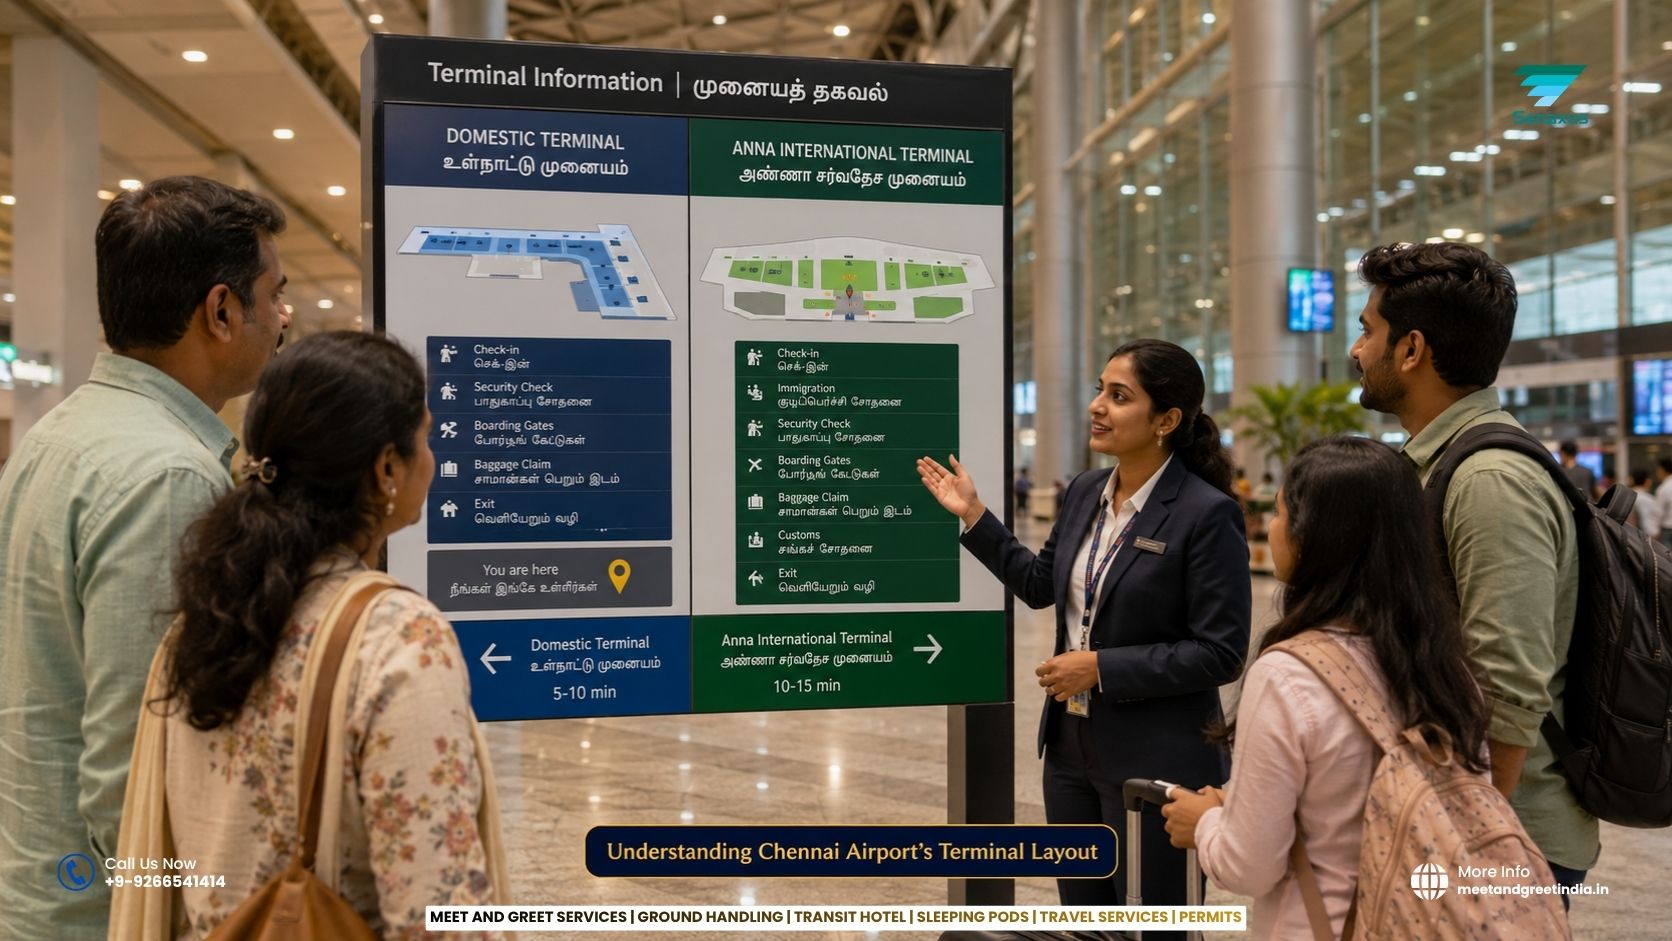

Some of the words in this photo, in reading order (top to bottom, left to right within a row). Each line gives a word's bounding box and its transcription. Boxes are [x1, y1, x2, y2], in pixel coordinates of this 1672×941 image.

[427, 61, 527, 86] Terminal
[534, 66, 663, 92] Information
[693, 77, 807, 104] முனையத்
[812, 81, 889, 105] தகவல்
[446, 127, 536, 147] DOMESTIC
[539, 131, 625, 150] TERMINAL
[732, 140, 776, 157] ANNA
[780, 142, 897, 161] INTERNATIONAL
[899, 146, 974, 164] TERMINAL
[443, 152, 536, 177] உள்நாட்டு
[540, 158, 629, 178] முனையம்
[738, 164, 812, 183] அண்ணா
[815, 166, 884, 189] சர்வதேச
[887, 171, 967, 190] முனையம்
[473, 344, 520, 355] Check-in
[777, 347, 820, 358] Check-in
[474, 381, 518, 395] Security
[520, 381, 554, 393] Check
[777, 383, 836, 398] Immigration
[474, 420, 522, 433] Boarding
[523, 420, 555, 431] Gates
[777, 418, 819, 431] Security
[820, 418, 851, 429] Check
[474, 459, 520, 473] Baggage
[521, 458, 552, 470] Claim
[778, 454, 821, 468] Boarding
[823, 455, 852, 465] Gates
[588, 472, 620, 487] இடம்
[474, 498, 495, 509] Exit
[821, 491, 849, 502] Claim
[882, 504, 913, 518] இடம்
[554, 511, 579, 527] வழி
[777, 529, 821, 540] Customs
[482, 564, 506, 576] You
[508, 566, 529, 576] are
[532, 563, 559, 576] here
[778, 567, 798, 578] Exit
[531, 637, 592, 652] Domestic
[594, 635, 650, 650] Terminal
[721, 633, 754, 647] Anna
[757, 631, 837, 646] International
[839, 630, 893, 644] Terminal
[530, 657, 595, 675] உள்நாட்டு
[597, 655, 661, 674] முனையம்
[720, 653, 776, 669] அண்ணா
[778, 651, 830, 668] சர்வதேச
[833, 650, 893, 668] முனையம்
[553, 685, 587, 701] 5-10
[590, 684, 617, 699] min
[773, 678, 812, 693] 10-15
[816, 677, 841, 692] min
